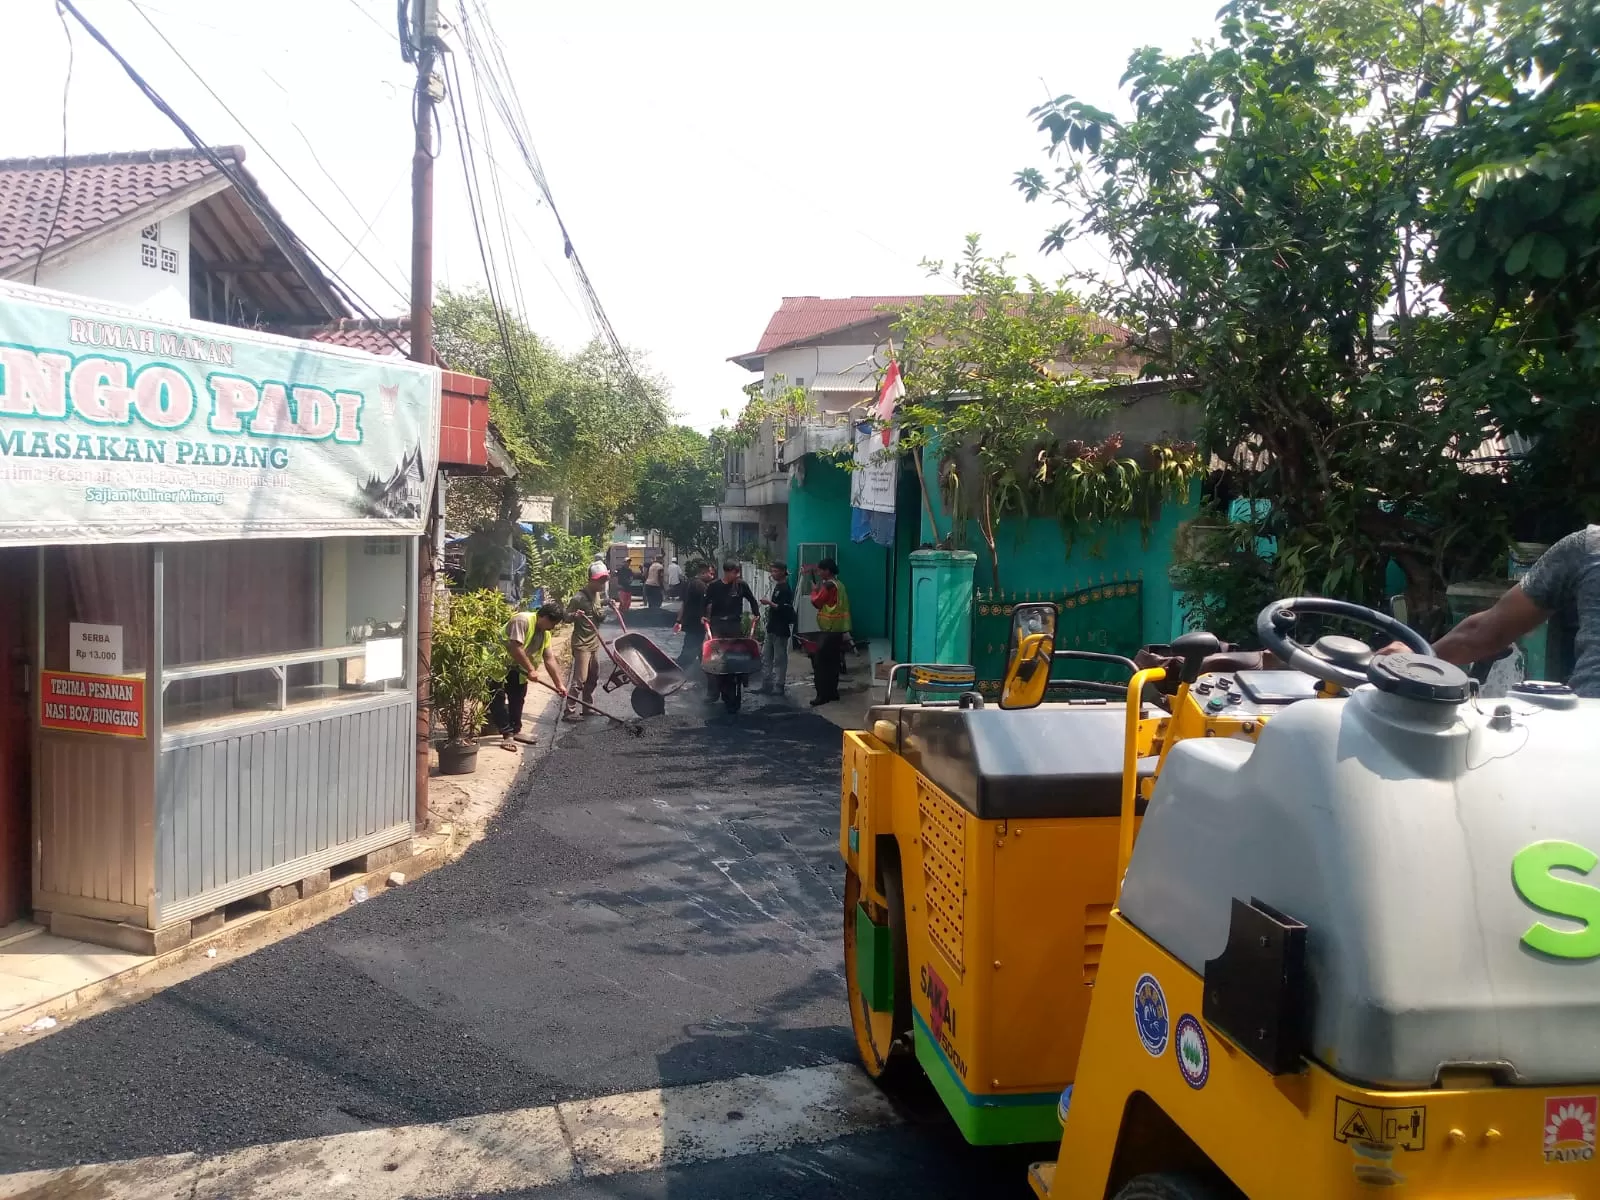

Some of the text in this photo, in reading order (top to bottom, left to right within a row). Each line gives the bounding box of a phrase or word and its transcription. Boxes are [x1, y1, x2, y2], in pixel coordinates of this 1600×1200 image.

[69, 317, 234, 367] RUMAH MAKAN
[206, 371, 364, 445] PADI
[0, 430, 289, 470] MASAKAN PADANG
[86, 486, 225, 505] Sajian Kuliner Minang
[82, 633, 111, 643] SERBA
[76, 649, 117, 661] Rp 13.000
[50, 678, 134, 701] TERIMA PESANAN
[45, 703, 139, 727] NASI BOX/BUNGKUS
[1543, 1148, 1593, 1163] TAIYO
